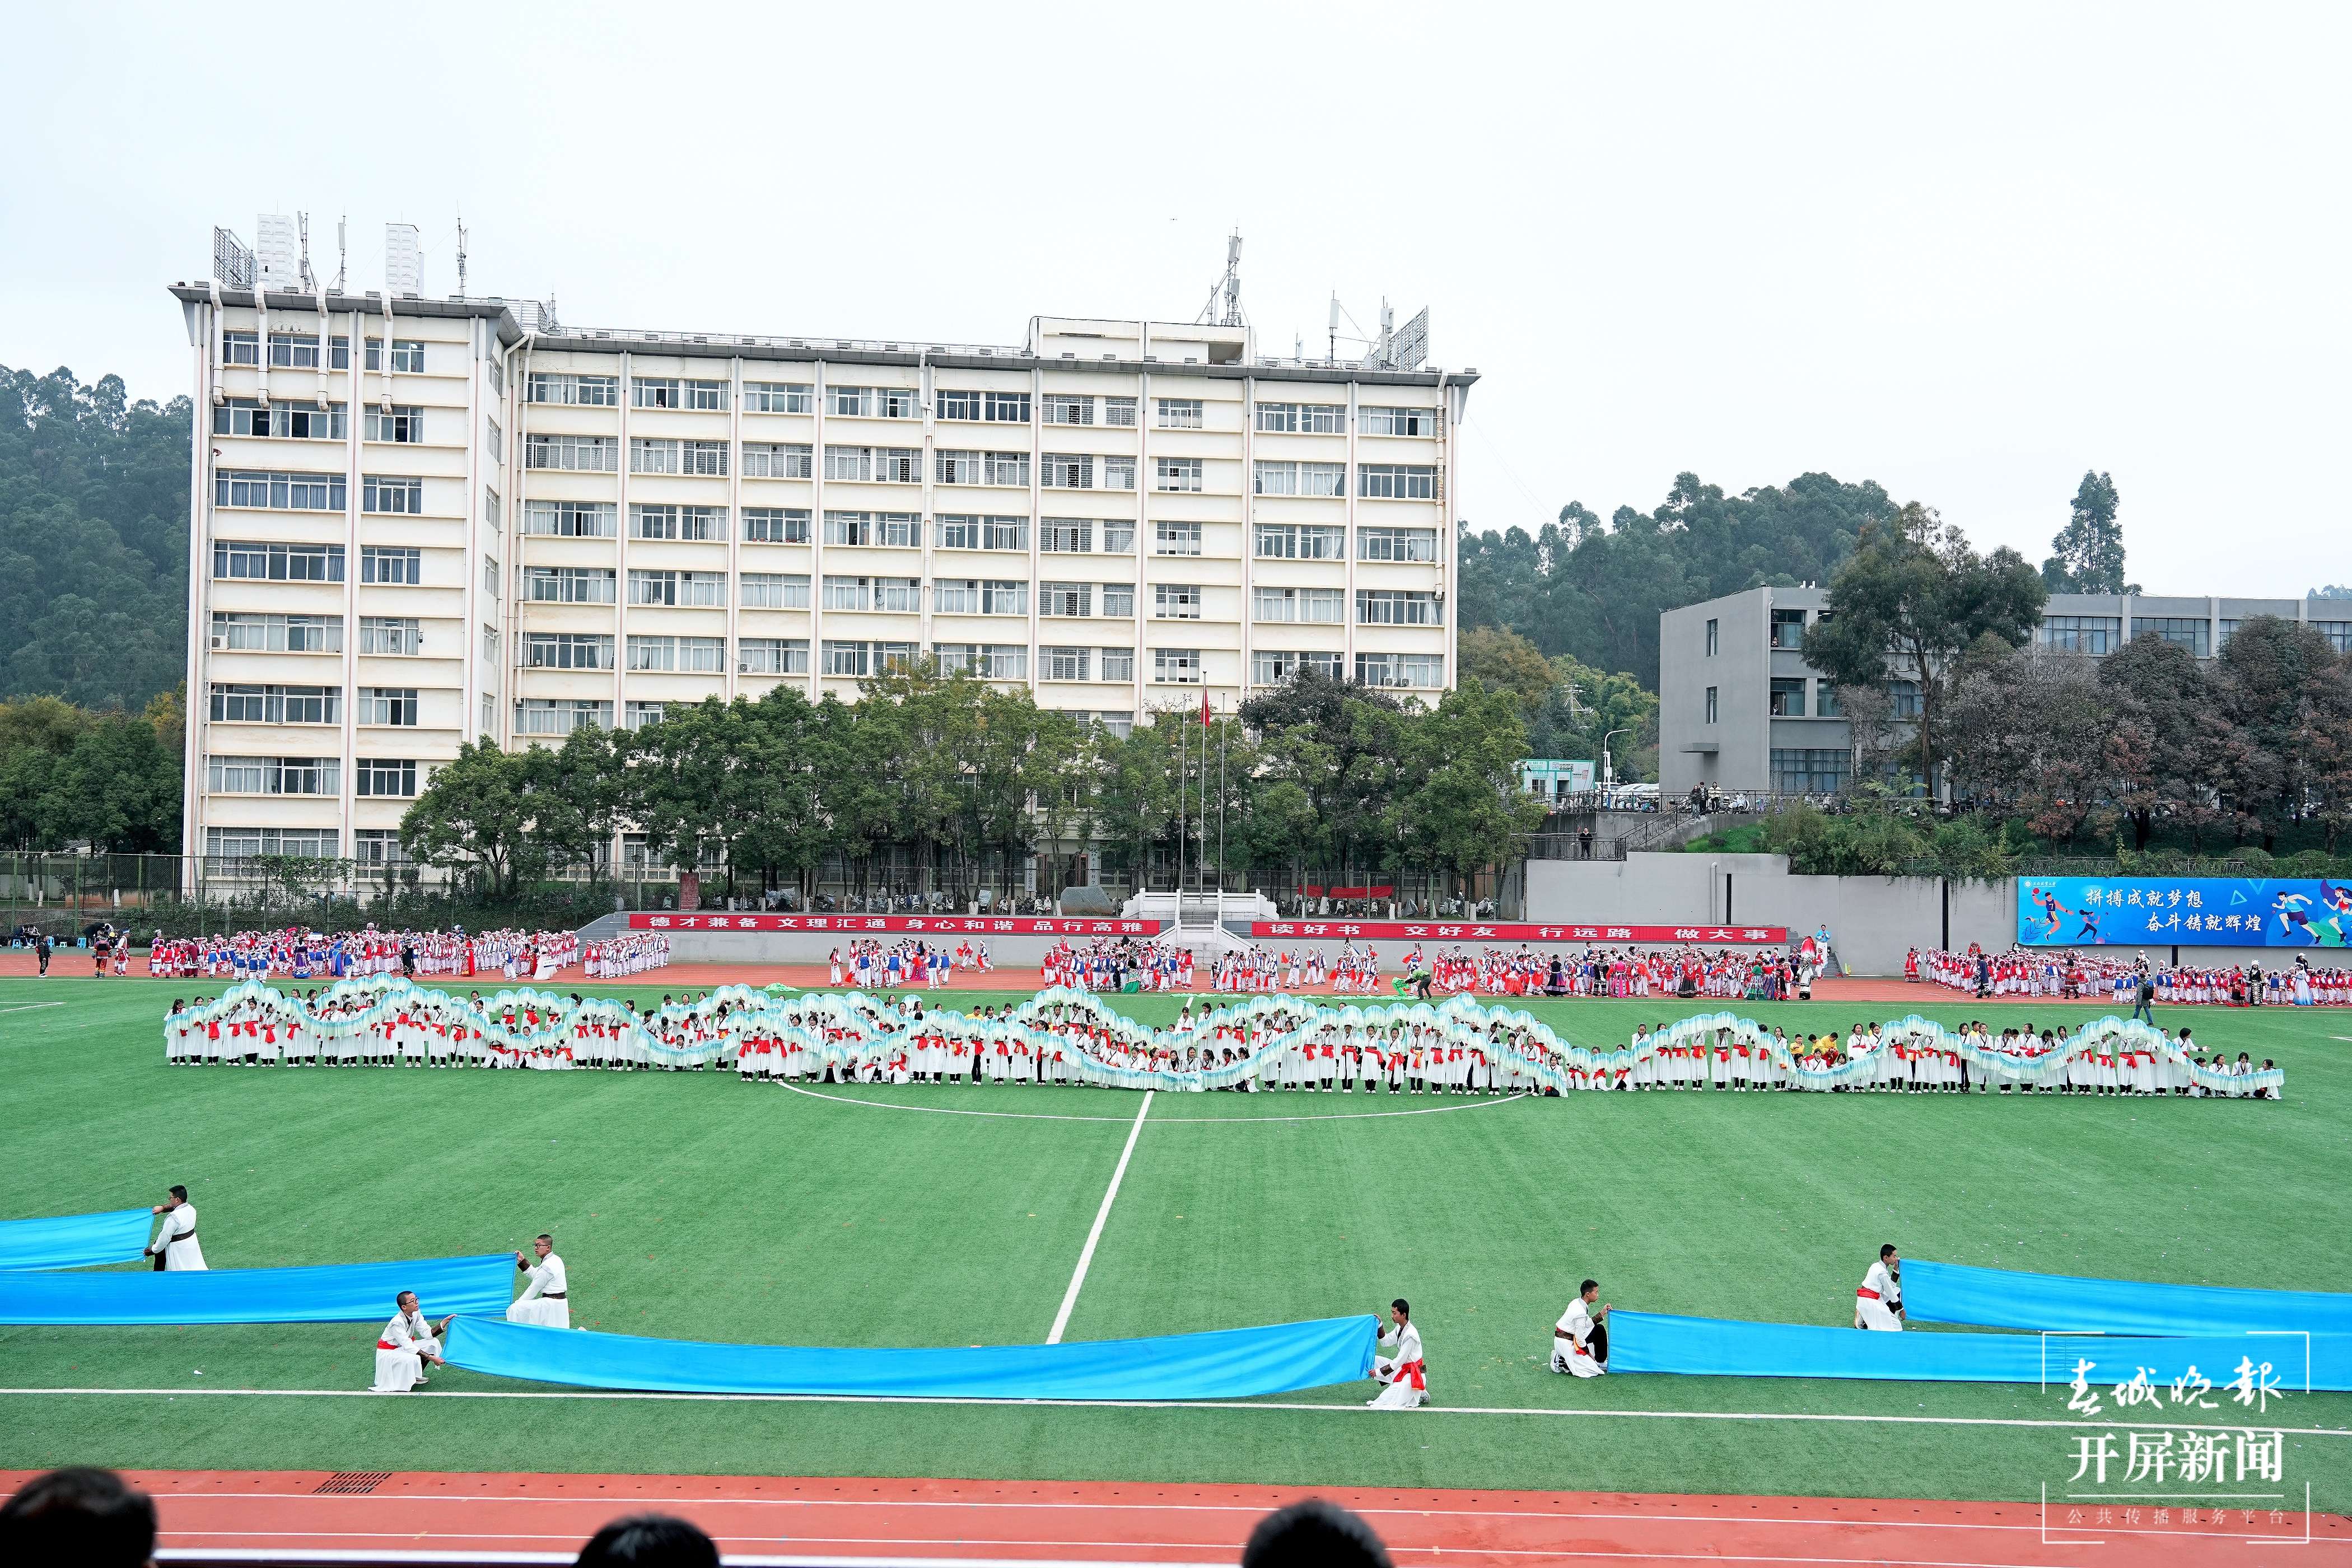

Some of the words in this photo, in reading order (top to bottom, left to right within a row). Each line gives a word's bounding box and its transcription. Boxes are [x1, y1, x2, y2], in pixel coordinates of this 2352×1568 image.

[2085, 888, 2204, 909] 拼搏成就梦想
[649, 916, 759, 928] 德才兼备
[777, 917, 886, 928] 文理汇通
[905, 919, 1015, 930] 身心和谐
[1033, 921, 1143, 932] 品行高雅
[2145, 911, 2262, 932] 奋斗铸就辉煌
[1268, 924, 1361, 935] 读好书
[1404, 926, 1497, 937] 交好友
[1538, 927, 1632, 939] 行远路
[1674, 928, 1769, 940] 做大事
